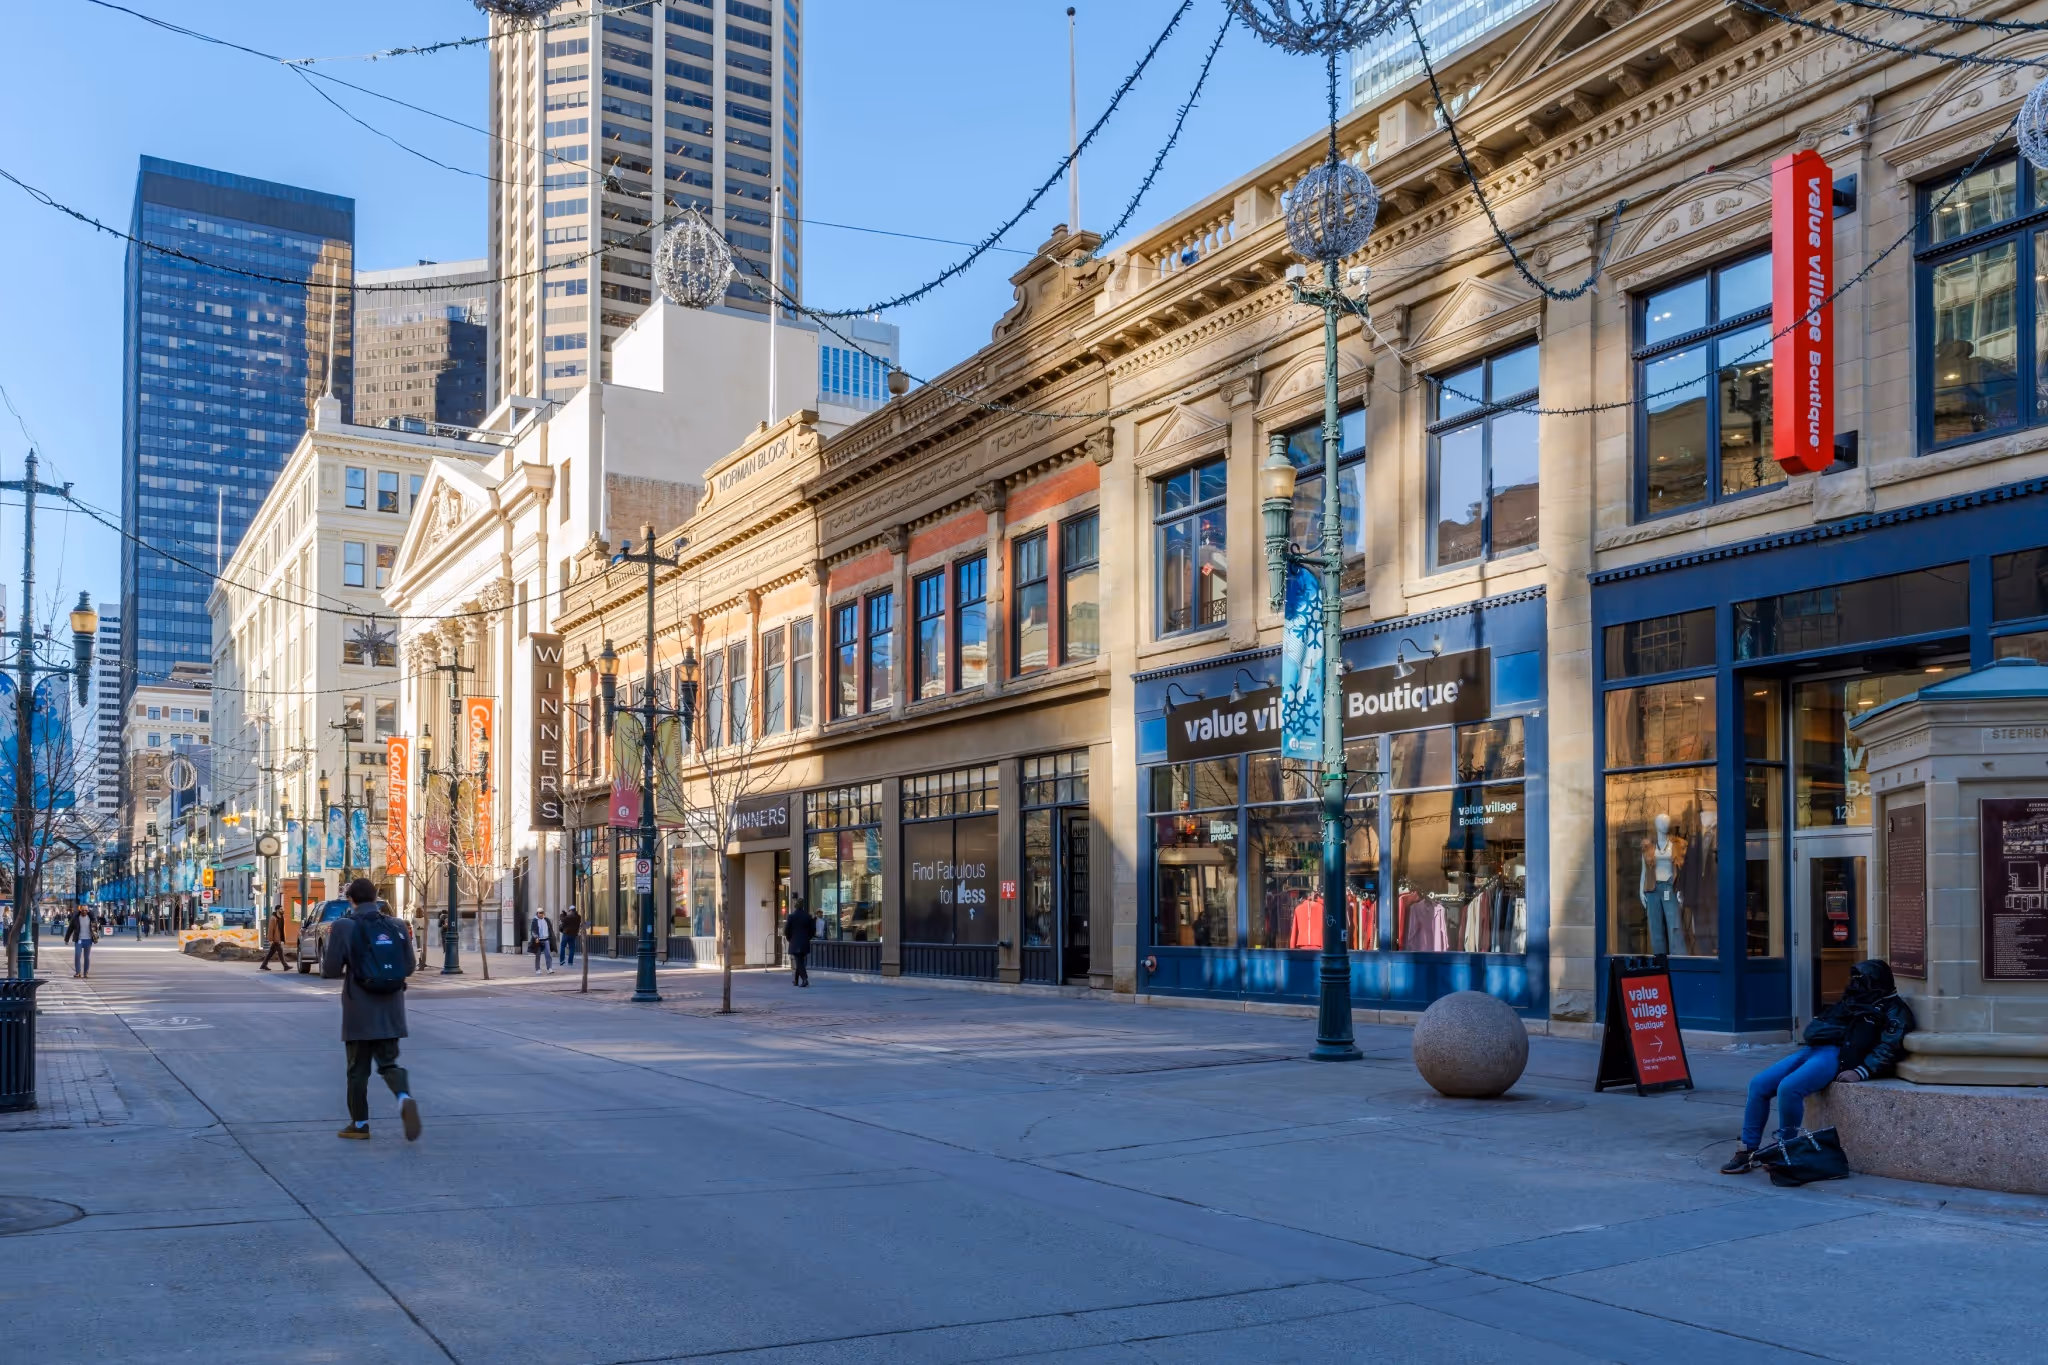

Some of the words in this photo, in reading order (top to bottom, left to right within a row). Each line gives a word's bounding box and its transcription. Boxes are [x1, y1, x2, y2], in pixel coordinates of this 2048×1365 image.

[1808, 177, 1824, 249] value
[1806, 255, 1825, 343] village
[1808, 350, 1821, 448] Boutique
[719, 457, 756, 493] NORMAN
[757, 436, 789, 470] BLOCK
[1185, 708, 1248, 743] value
[1348, 680, 1459, 718] Boutique
[536, 645, 563, 819] WINNERS
[389, 743, 407, 803] GoodLife
[1459, 804, 1484, 815] value
[1485, 801, 1517, 813] village
[1835, 805, 1857, 820] 120
[1211, 824, 1230, 834] thrift
[1459, 816, 1493, 826] Boutique
[1211, 832, 1234, 843] proud.
[912, 861, 934, 881] Find
[937, 859, 986, 880] Fabulous
[940, 886, 953, 904] for
[957, 880, 986, 904] Less
[1002, 882, 1015, 893] FDC
[1628, 986, 1659, 1001] value
[1631, 1002, 1668, 1018] village
[1634, 1020, 1664, 1031] Boutique
